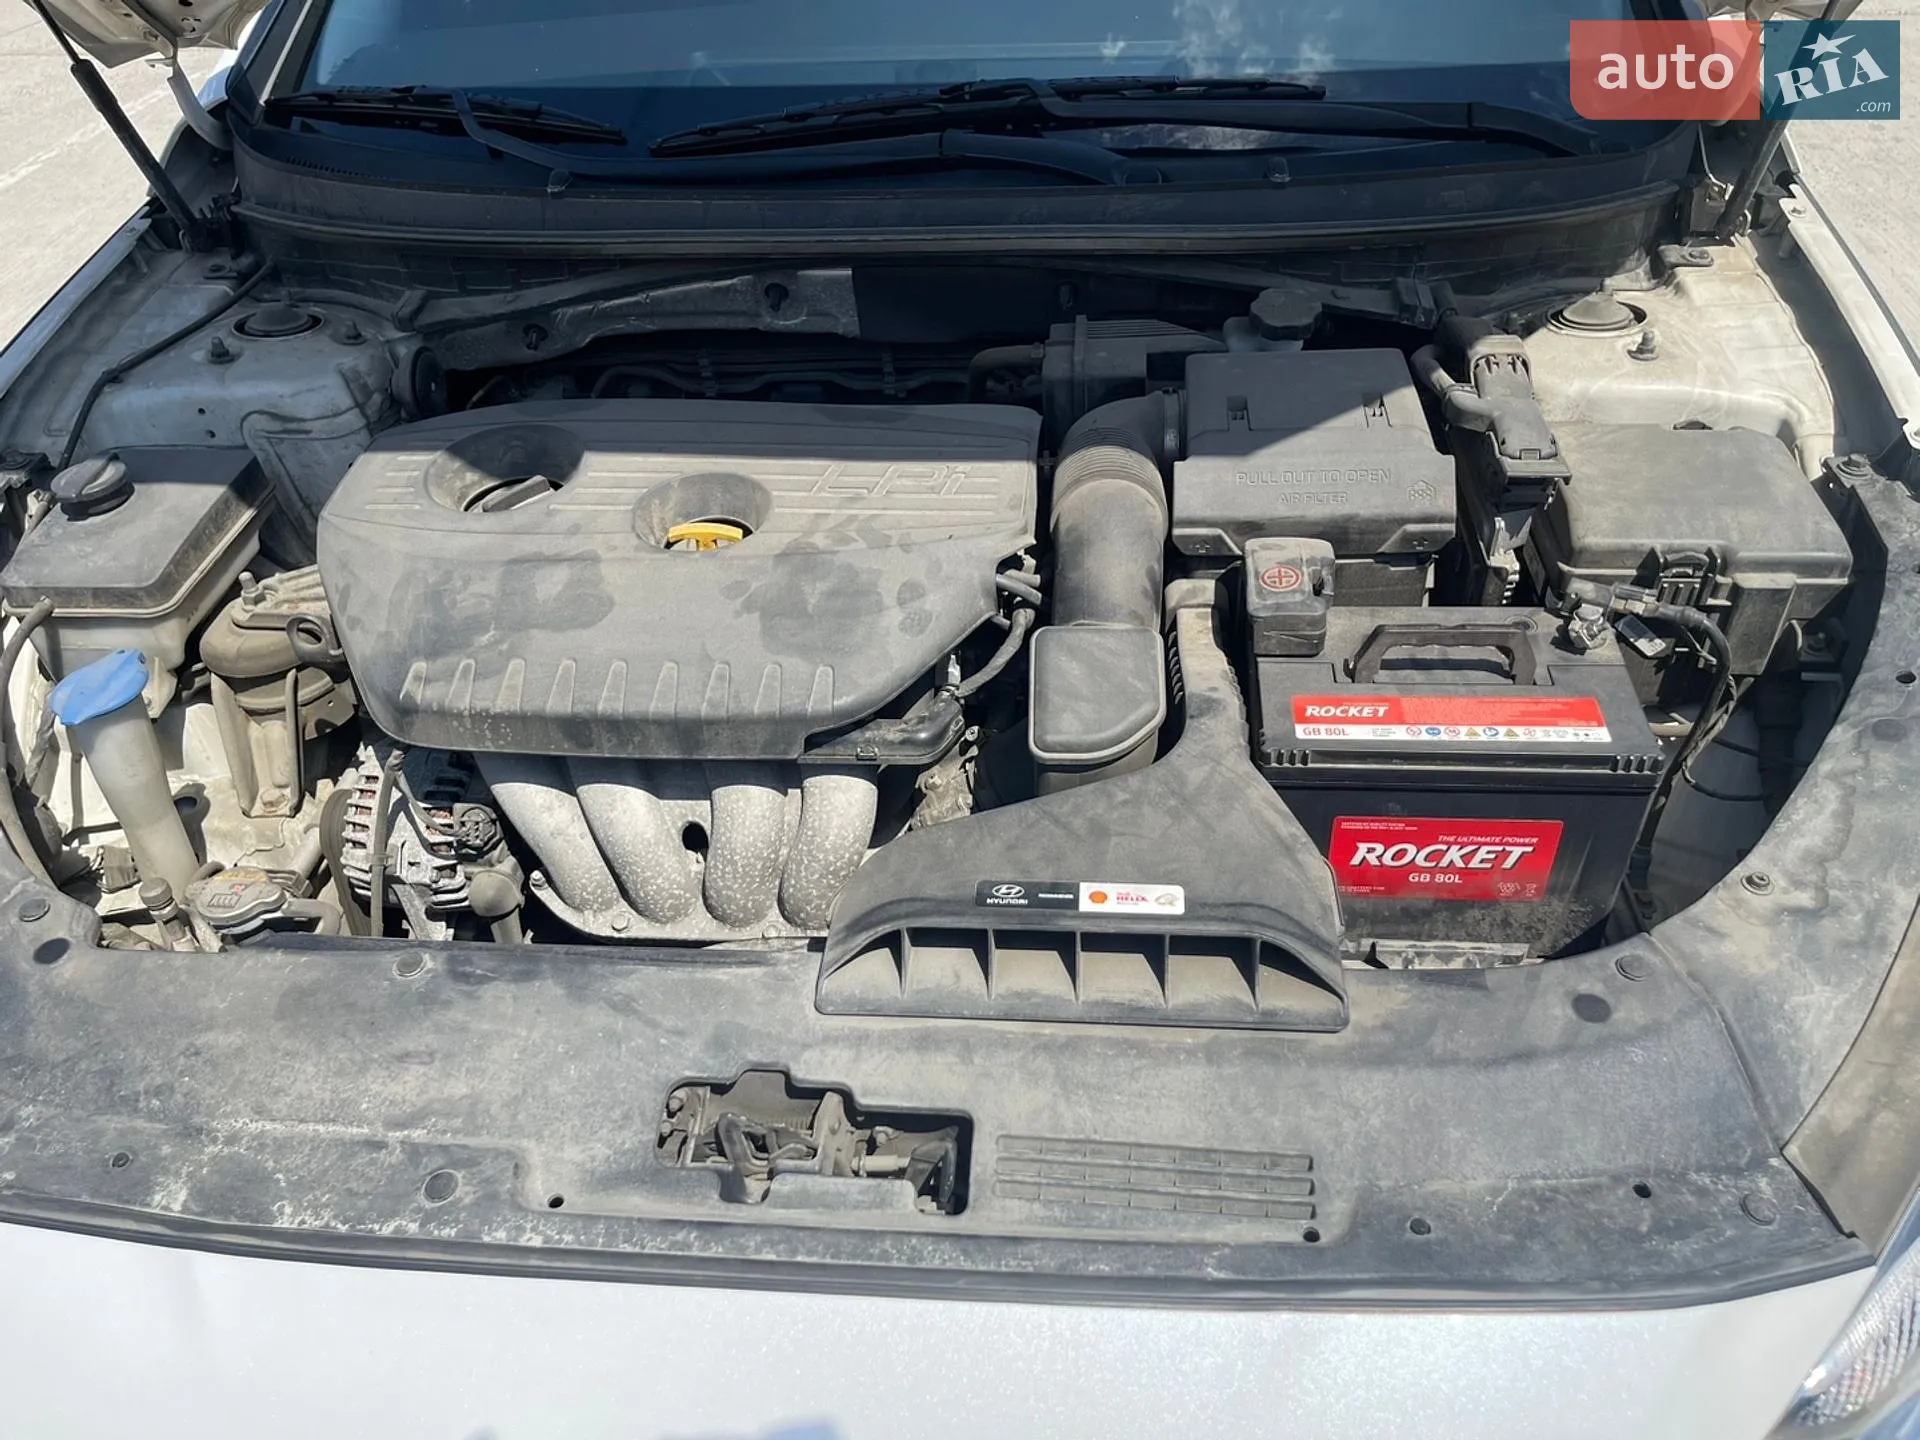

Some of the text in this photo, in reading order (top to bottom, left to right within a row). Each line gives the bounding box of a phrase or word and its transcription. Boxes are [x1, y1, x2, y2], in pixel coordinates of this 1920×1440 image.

[1236, 469, 1392, 486] PULL OUT TO OPEN
[1279, 492, 1300, 504] AIR
[1305, 704, 1389, 717] ROCKET
[1303, 727, 1349, 736] GB 80L
[1457, 835, 1502, 843] ULTIMATE
[1349, 842, 1535, 870] ROCKET
[1408, 873, 1463, 884] GB 80L
